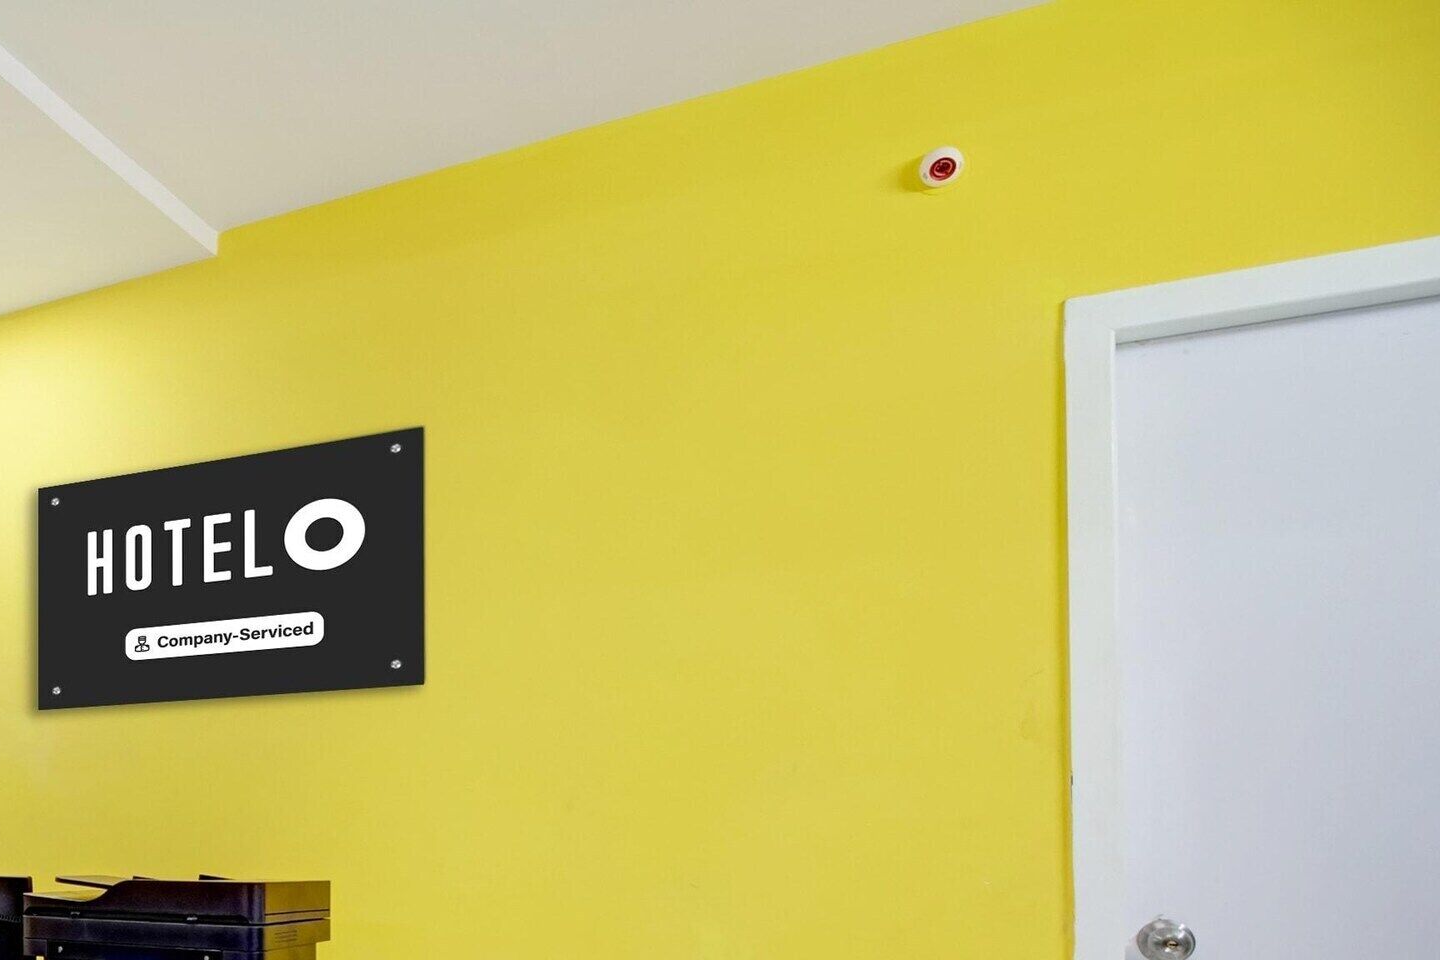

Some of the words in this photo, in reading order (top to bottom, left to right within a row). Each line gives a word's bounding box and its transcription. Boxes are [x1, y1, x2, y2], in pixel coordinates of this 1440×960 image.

[87, 509, 274, 596] HOTEL
[283, 498, 366, 571] O
[157, 621, 314, 649] Company-Serviced
